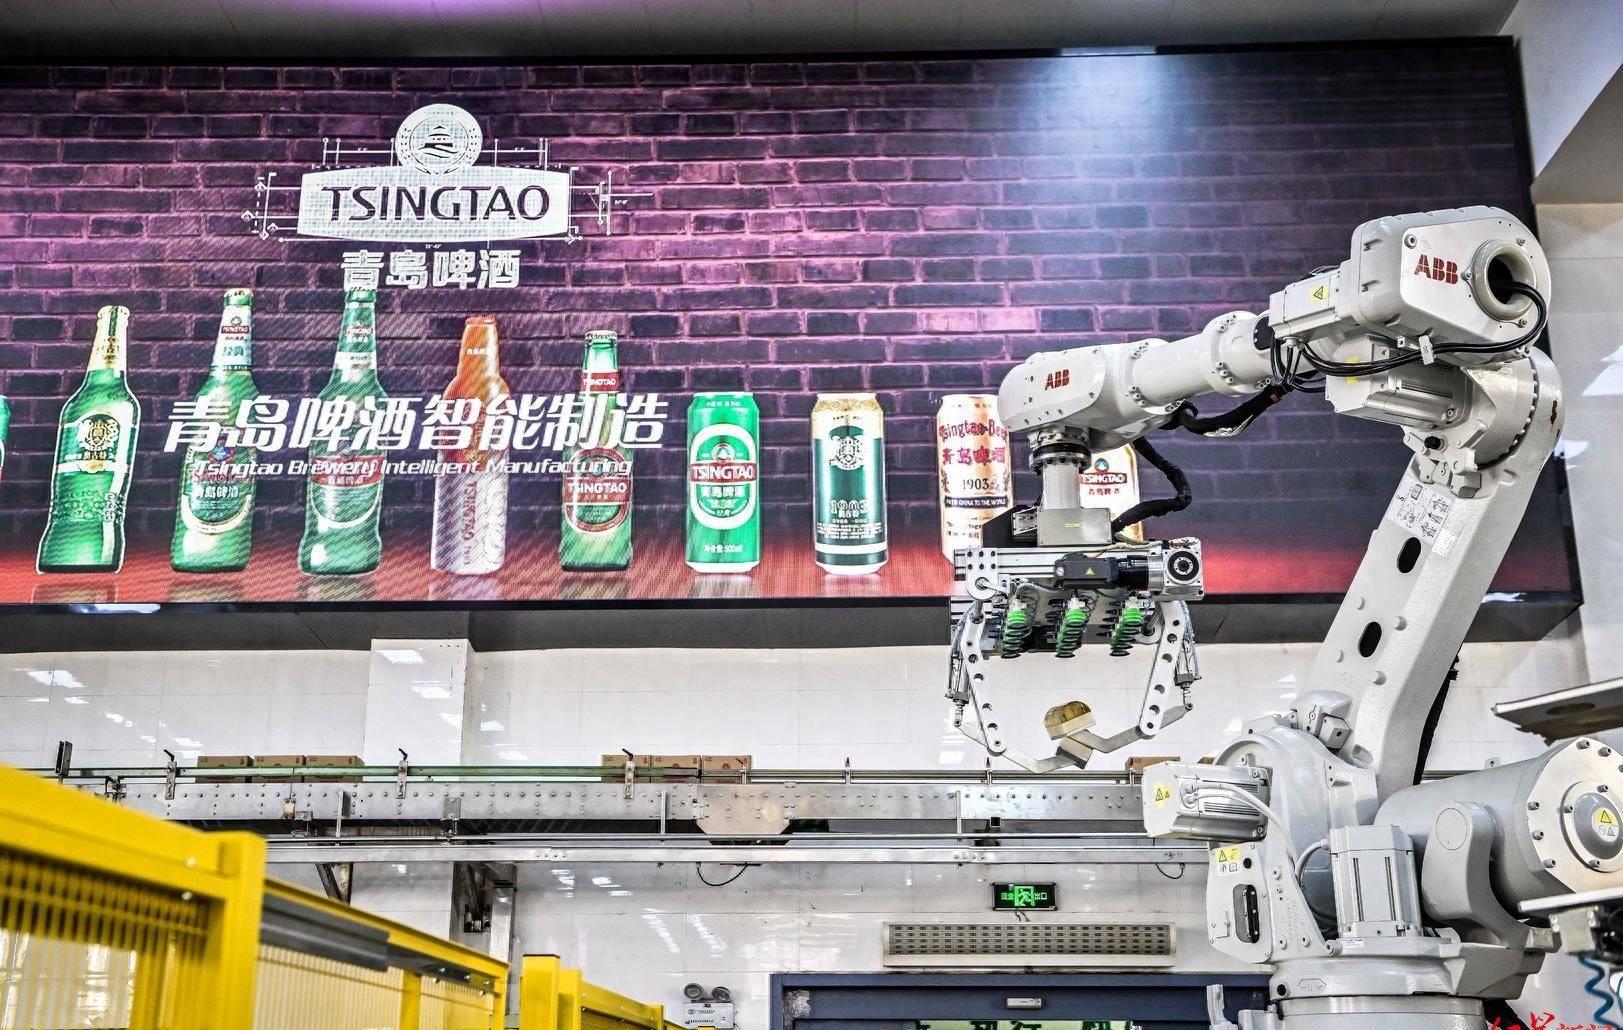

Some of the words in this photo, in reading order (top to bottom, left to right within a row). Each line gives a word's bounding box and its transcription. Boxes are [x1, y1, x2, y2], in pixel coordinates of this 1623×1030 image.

[321, 185, 550, 221] TSINGTAO
[341, 249, 521, 290] 青島啤酒
[1414, 254, 1459, 285] ABB
[1045, 369, 1070, 390] ABB
[164, 393, 669, 452] 青岛啤酒智能制造
[196, 460, 283, 477] Tsingtao
[380, 459, 481, 476] Intelligent
[485, 459, 632, 476] Manufacturing
[692, 465, 755, 480] TSINGTAO
[567, 482, 628, 494] TSINGTAO
[962, 478, 990, 490] 1903
[1081, 474, 1126, 484] TSINGTAO
[1034, 892, 1047, 900] 出口
